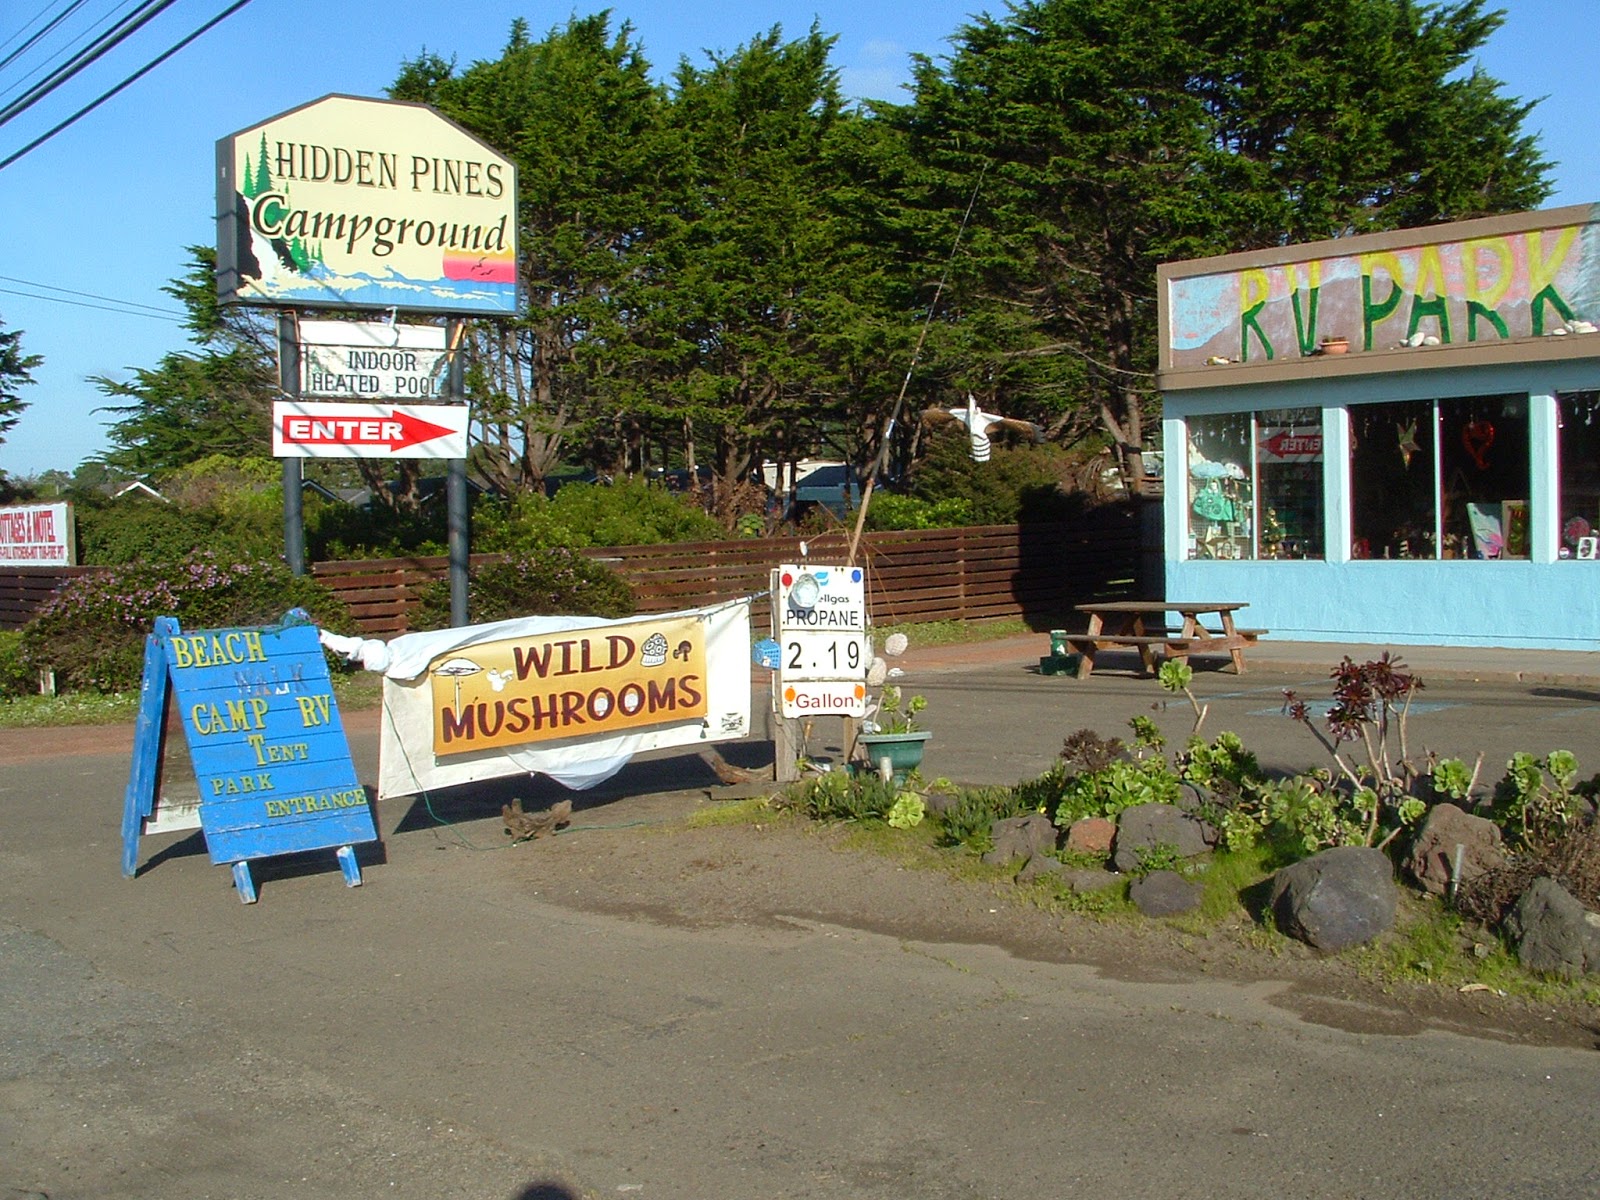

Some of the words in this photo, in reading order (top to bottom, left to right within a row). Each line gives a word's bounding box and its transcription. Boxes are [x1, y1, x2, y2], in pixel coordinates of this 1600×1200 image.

[275, 141, 397, 190] HIDDEN
[411, 156, 504, 198] PINES
[252, 193, 508, 257] Campground
[1239, 260, 1321, 363] RV
[1360, 226, 1581, 352] PARK
[348, 351, 417, 372] INDOOR
[312, 373, 380, 393] HEATED
[395, 376, 440, 395] POOL
[289, 420, 404, 440] ENTER
[786, 609, 859, 626] PROPANE
[170, 631, 268, 669] BEACH
[513, 635, 636, 681] WILD
[788, 641, 860, 669] 2.19
[192, 698, 269, 735] CAMP
[295, 694, 332, 728] RV
[442, 674, 702, 744] MUSHROOMS
[796, 693, 854, 708] Gallon
[211, 773, 275, 795] PARK
[265, 788, 368, 817] ENTRANCE
